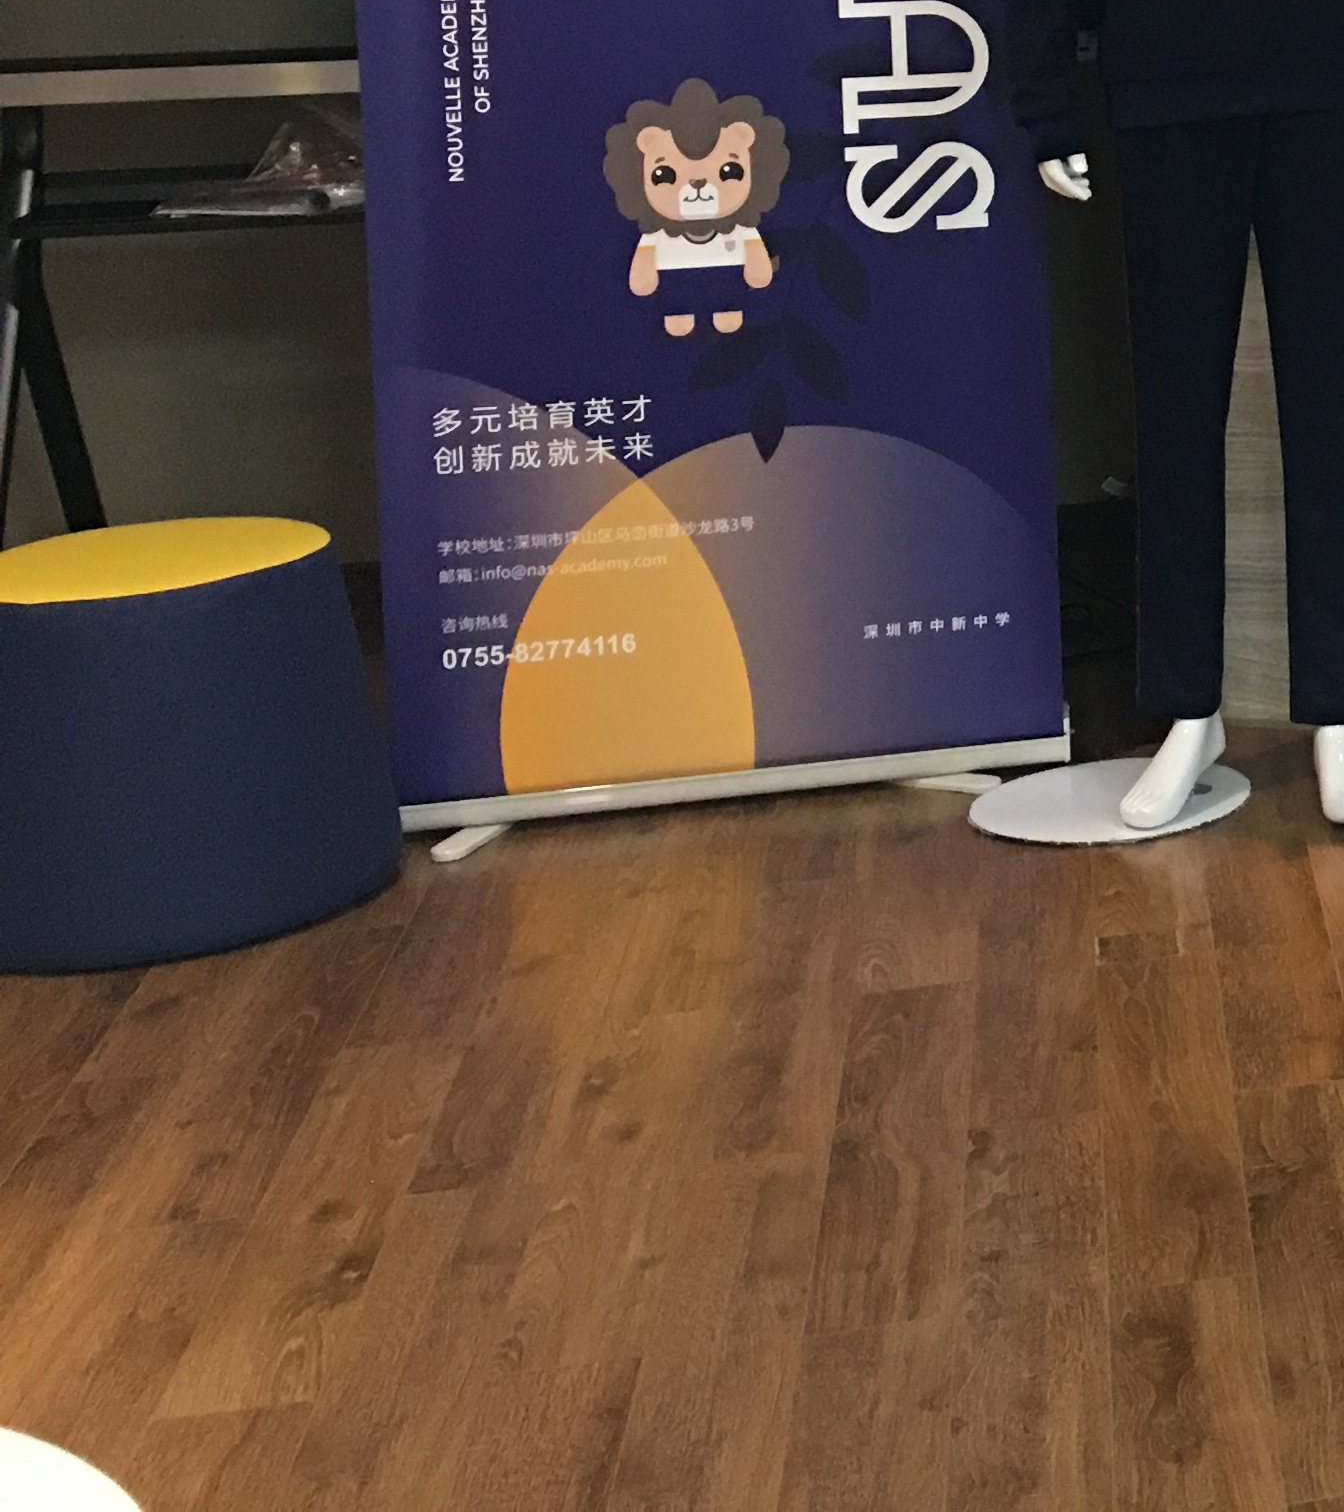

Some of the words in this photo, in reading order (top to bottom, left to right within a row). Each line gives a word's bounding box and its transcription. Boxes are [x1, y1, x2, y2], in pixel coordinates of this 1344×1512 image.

[474, 85, 491, 114] OF
[444, 76, 465, 182] NOUVELLE
[431, 394, 653, 438] 多元培育英才
[432, 432, 656, 477] 创新成就未来
[440, 613, 509, 635] 咨询热线
[863, 611, 1011, 639] 深圳市中新中学
[442, 633, 637, 670] 0755-82774116
